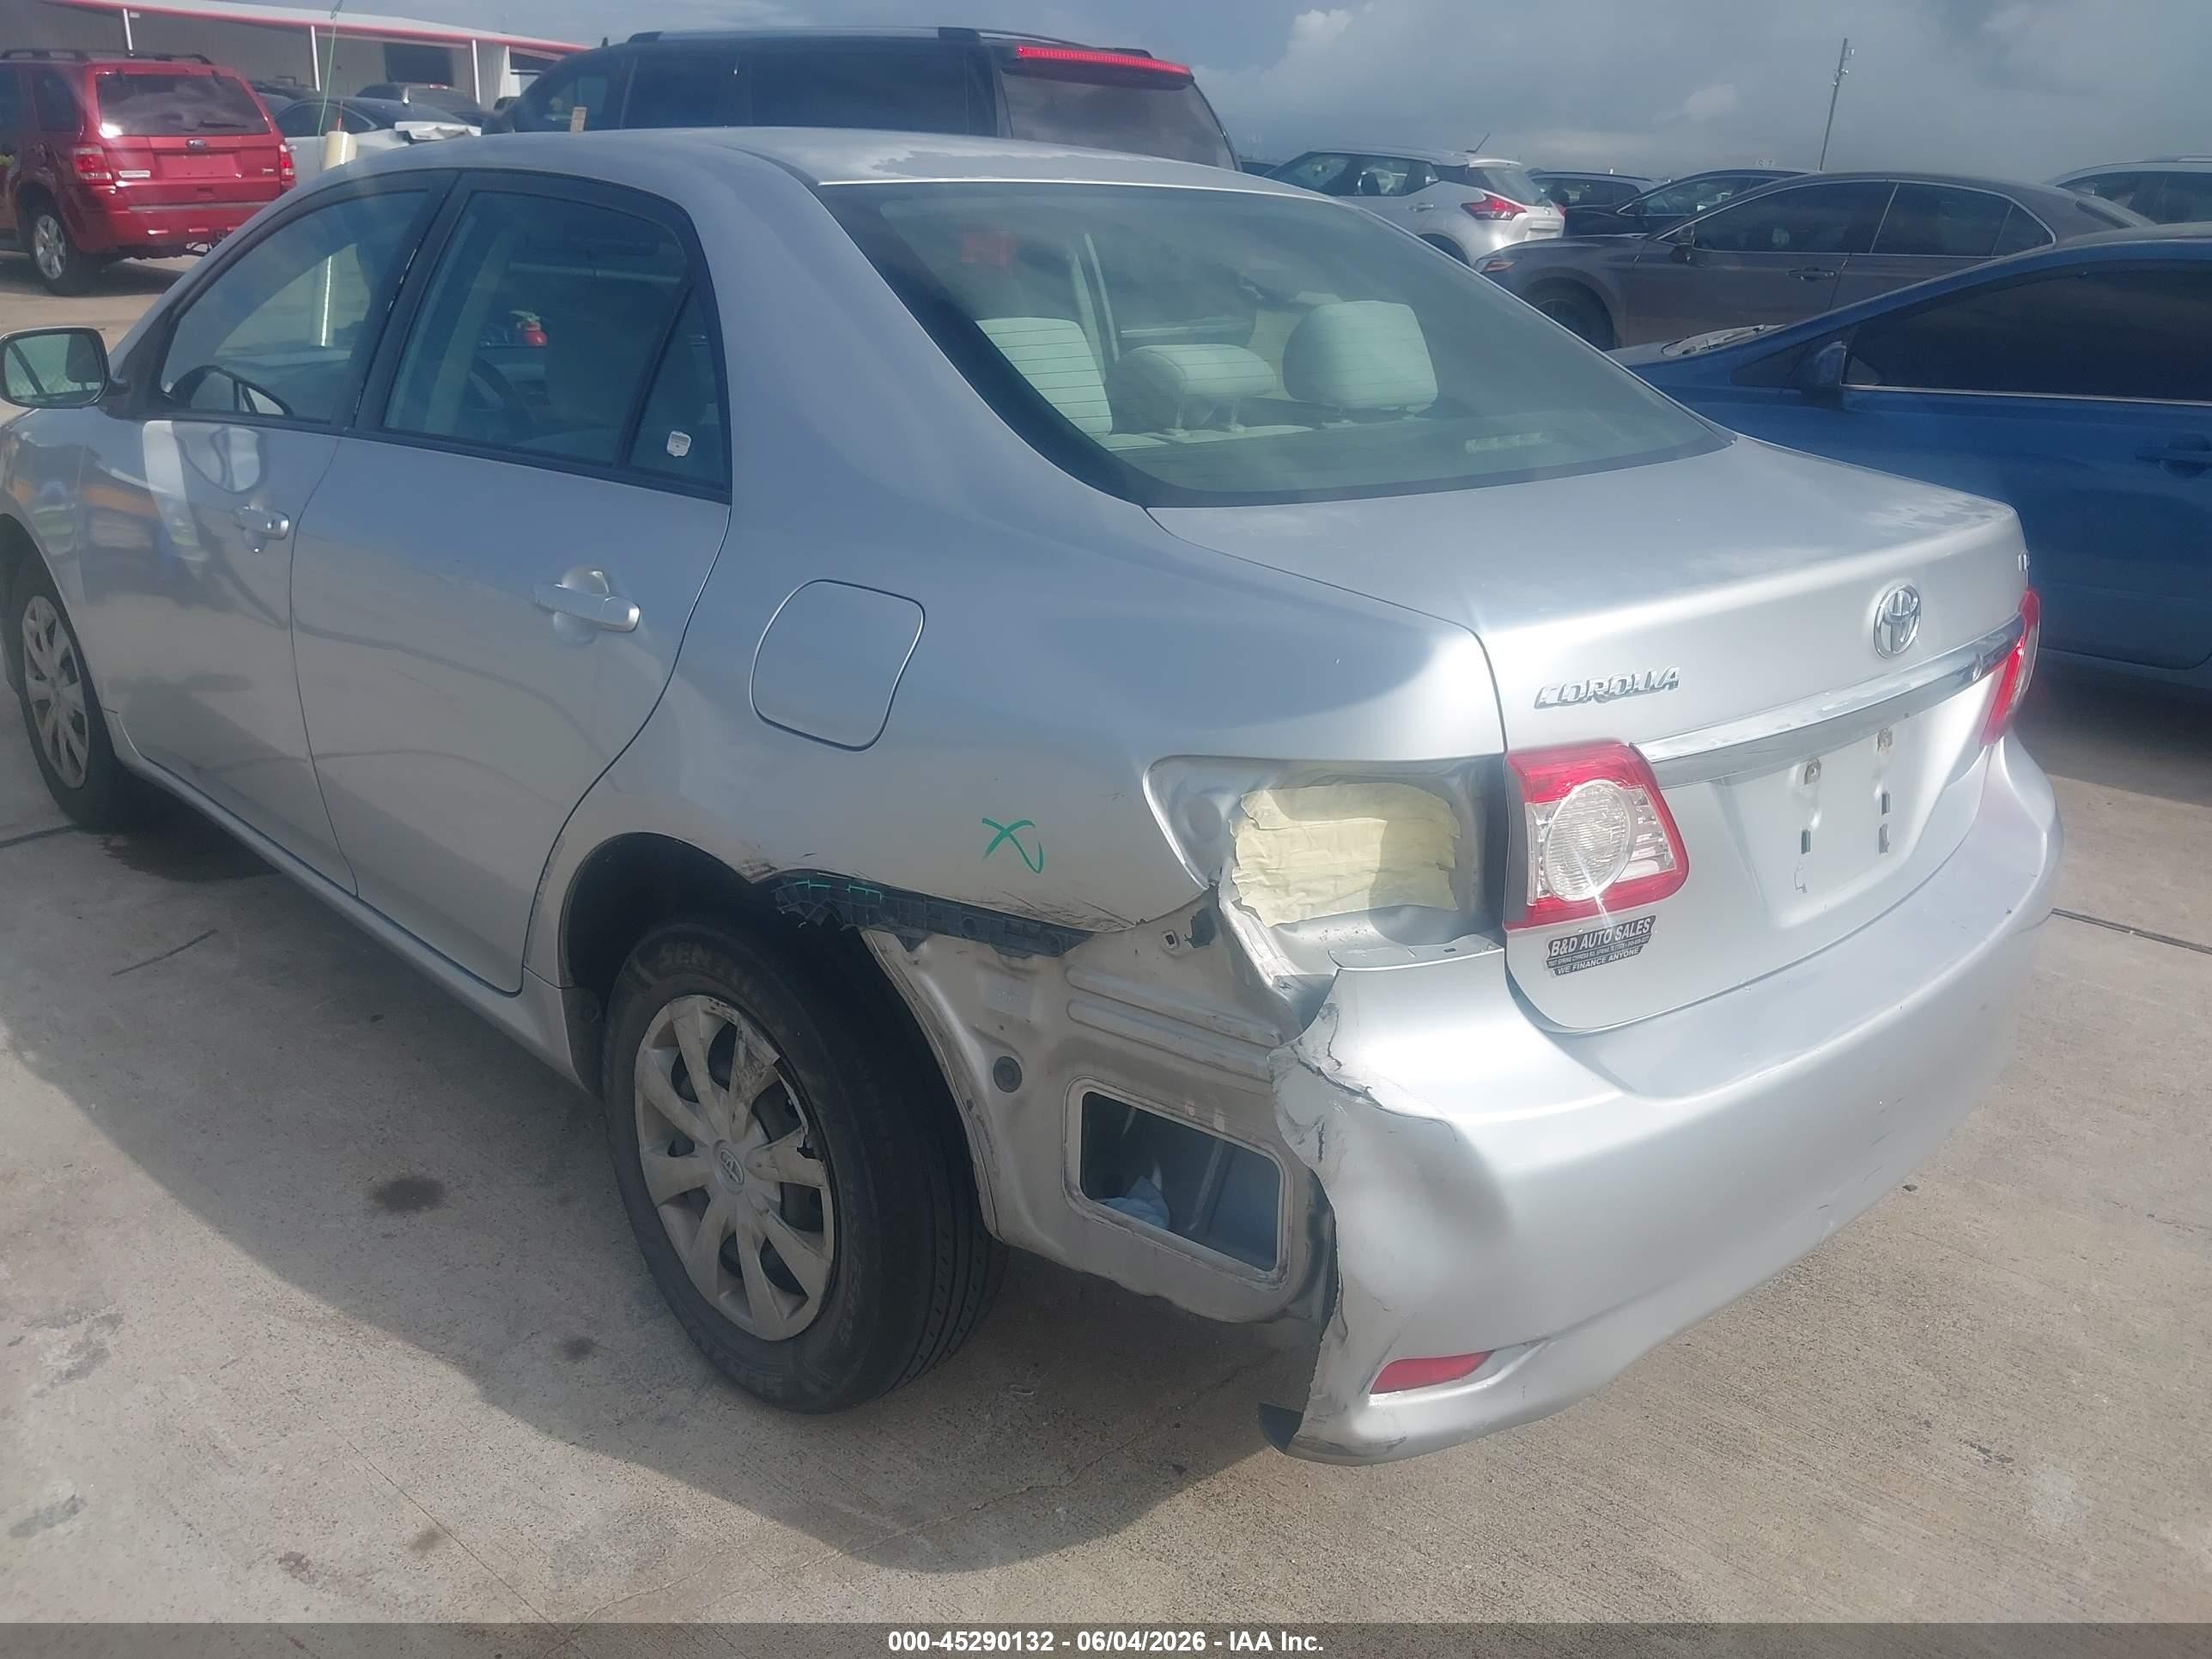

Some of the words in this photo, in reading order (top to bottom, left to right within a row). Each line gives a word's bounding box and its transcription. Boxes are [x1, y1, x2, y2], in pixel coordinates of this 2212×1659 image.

[1534, 666, 1680, 708] COROLLA
[1550, 937, 1577, 957] B&D
[1580, 928, 1613, 951] AUTO
[1614, 918, 1651, 941] SALES
[1558, 965, 1571, 975] WE
[1572, 957, 1607, 970] FINANCE
[1608, 947, 1639, 962] ANYONE
